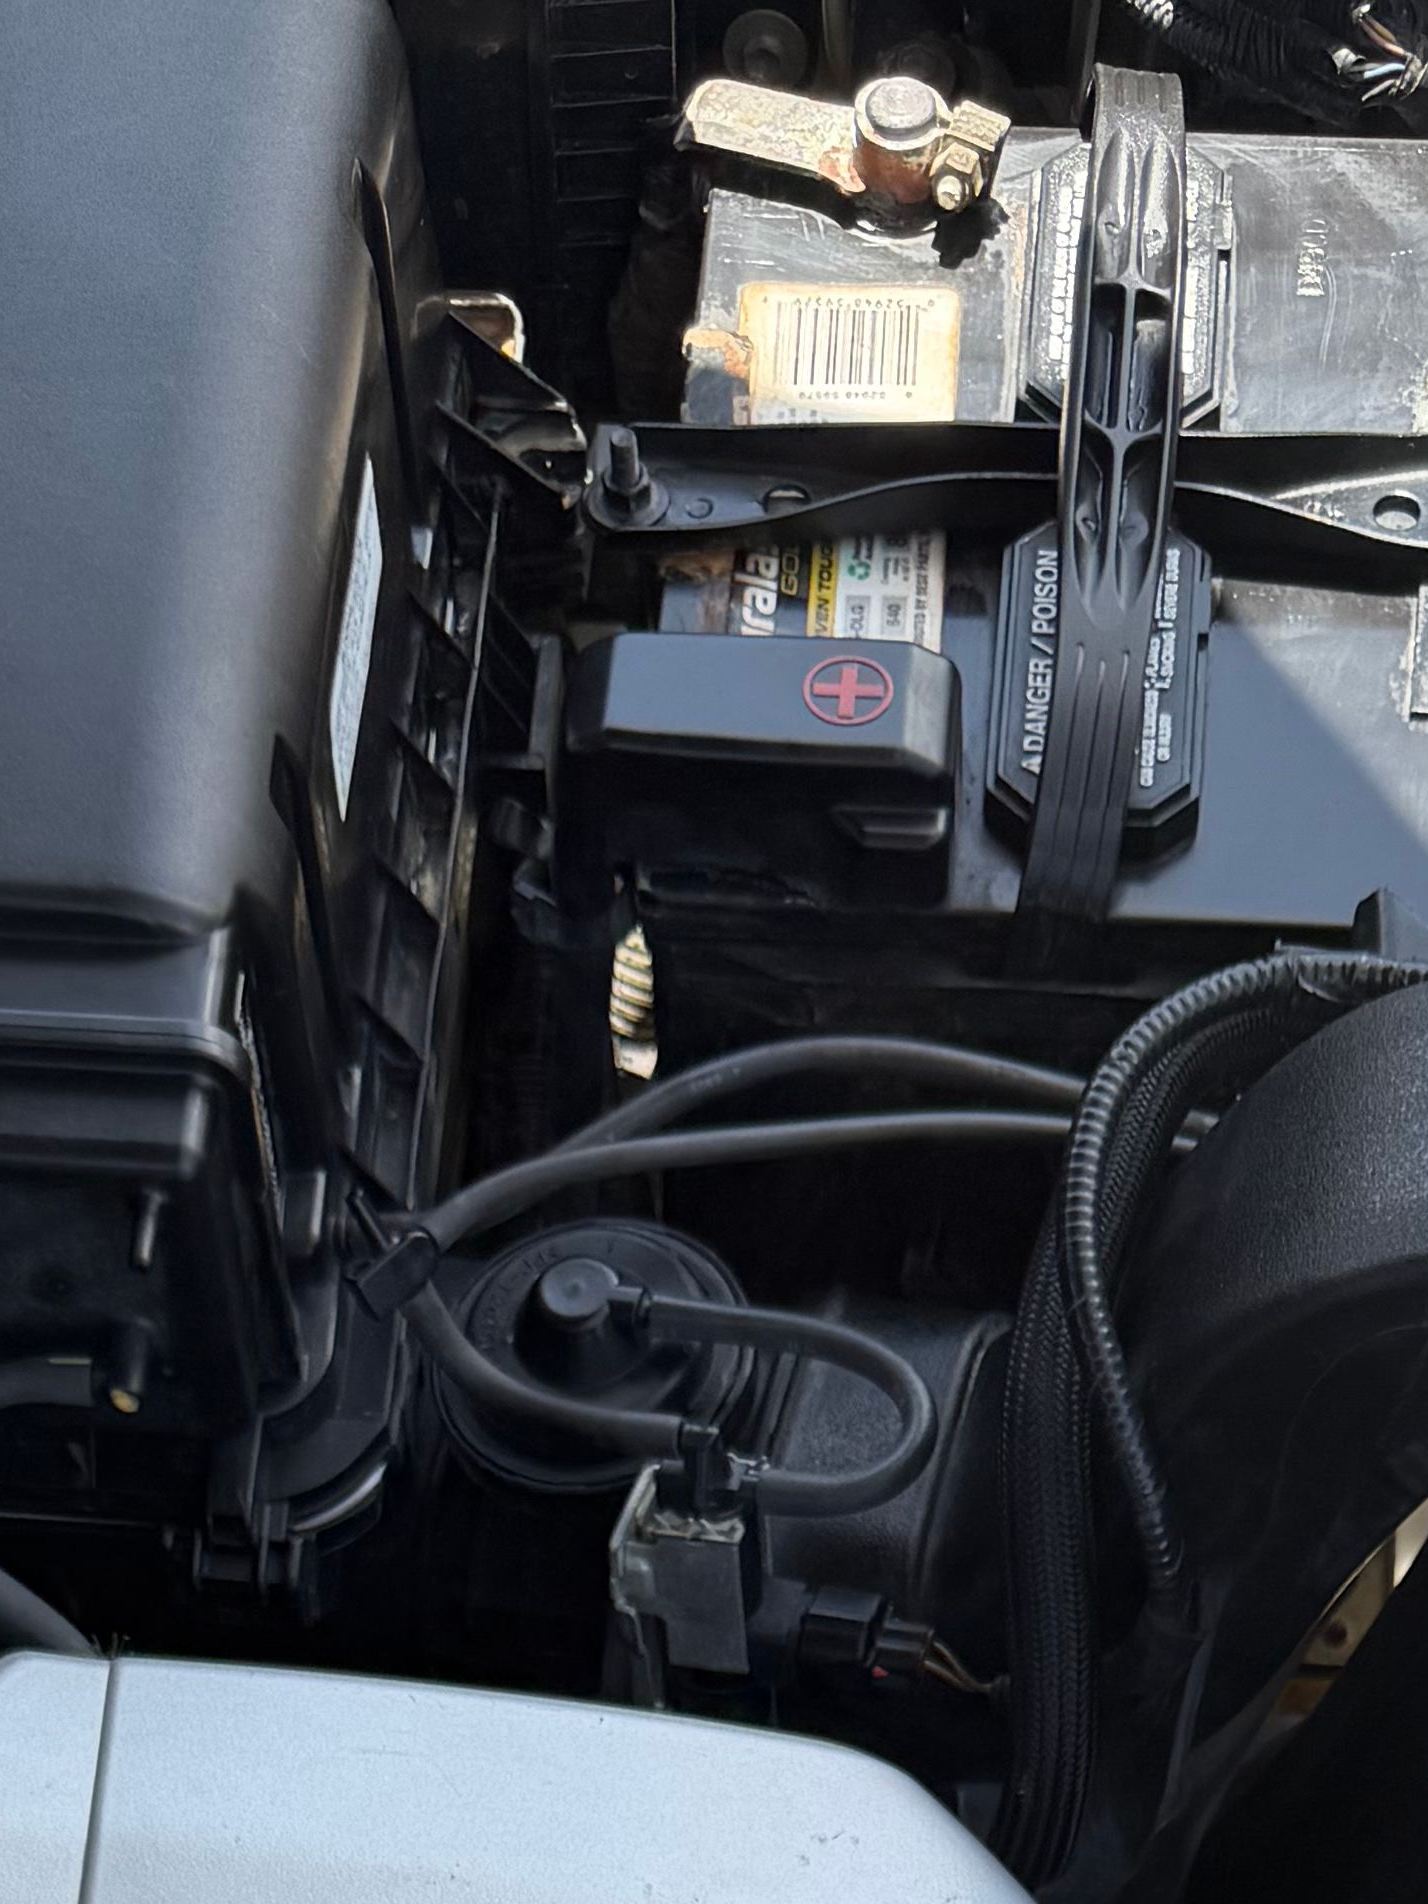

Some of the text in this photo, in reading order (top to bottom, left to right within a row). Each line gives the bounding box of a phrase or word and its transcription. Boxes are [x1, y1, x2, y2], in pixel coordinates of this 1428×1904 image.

[1023, 549, 1059, 752] DANGER / POISON
